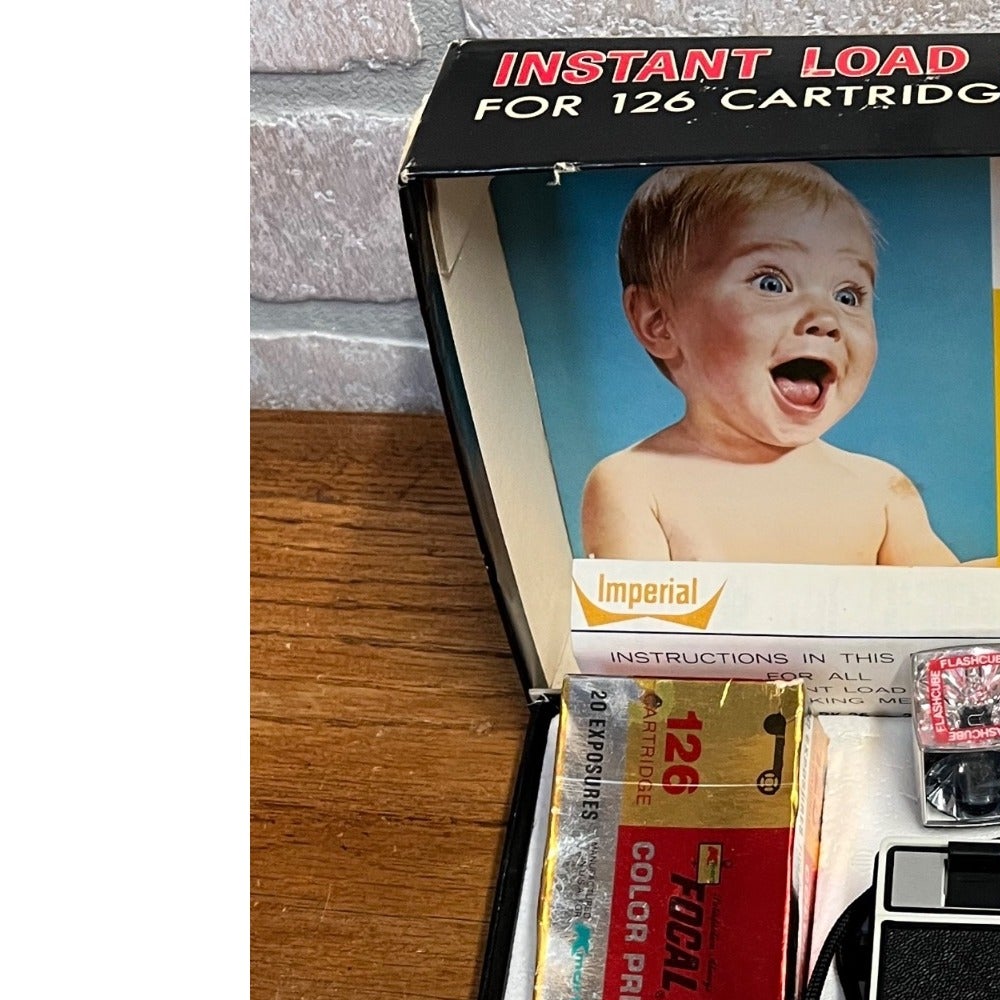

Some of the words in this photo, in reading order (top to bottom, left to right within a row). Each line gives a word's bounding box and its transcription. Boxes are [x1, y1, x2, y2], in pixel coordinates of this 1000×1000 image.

[493, 48, 771, 88] INSTANT
[800, 45, 970, 79] LOAD
[474, 96, 582, 121] FOR
[612, 90, 696, 115] 126
[598, 573, 698, 610] Imperial
[610, 651, 789, 665] INSTRUCTIONS
[803, 653, 825, 664] IN
[841, 653, 895, 664] THIS
[767, 672, 813, 681] FOR
[829, 672, 872, 681] ALL
[590, 690, 608, 712] 20
[844, 686, 906, 694] LOAD
[930, 671, 945, 732] FLASHCUBE
[581, 720, 606, 821] EXPOSURES
[636, 694, 660, 806] ARTRIDGE
[661, 711, 703, 795] 126
[624, 841, 655, 943] COLOR
[662, 873, 706, 991] FOCAL
